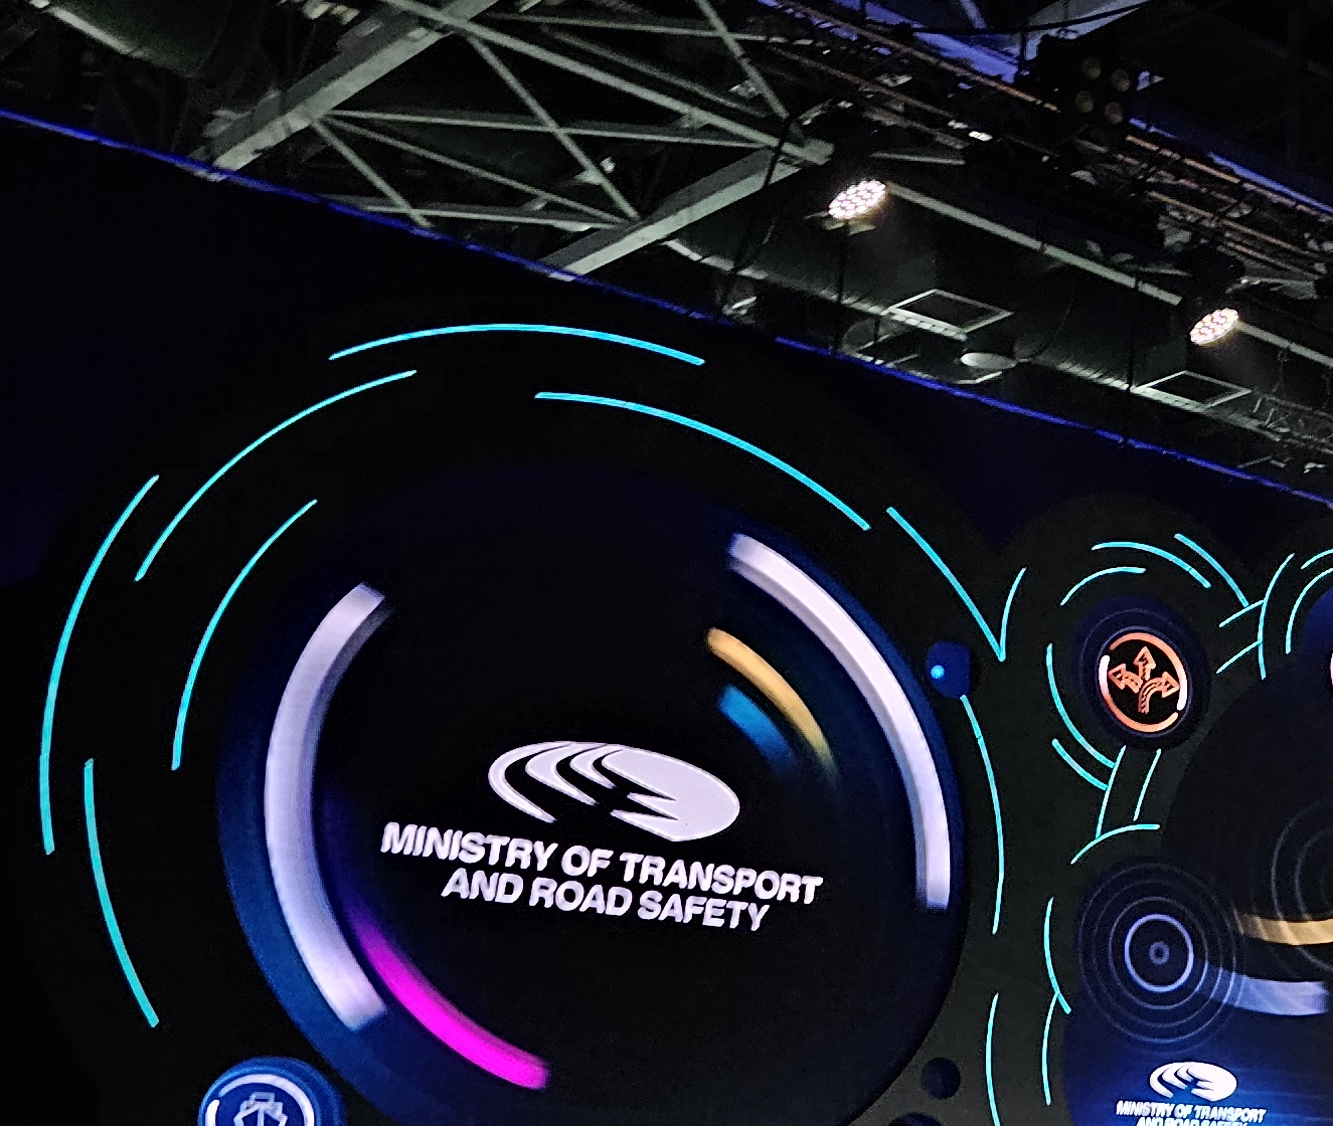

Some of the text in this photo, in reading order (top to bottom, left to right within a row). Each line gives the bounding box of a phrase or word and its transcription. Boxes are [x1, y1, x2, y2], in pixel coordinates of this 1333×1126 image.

[381, 822, 823, 905] MINISTRY OF TRANSPORT
[441, 868, 770, 932] AND ROAD SAFETY
[1115, 1100, 1267, 1124] MINISTRY OF TRANSPORT
